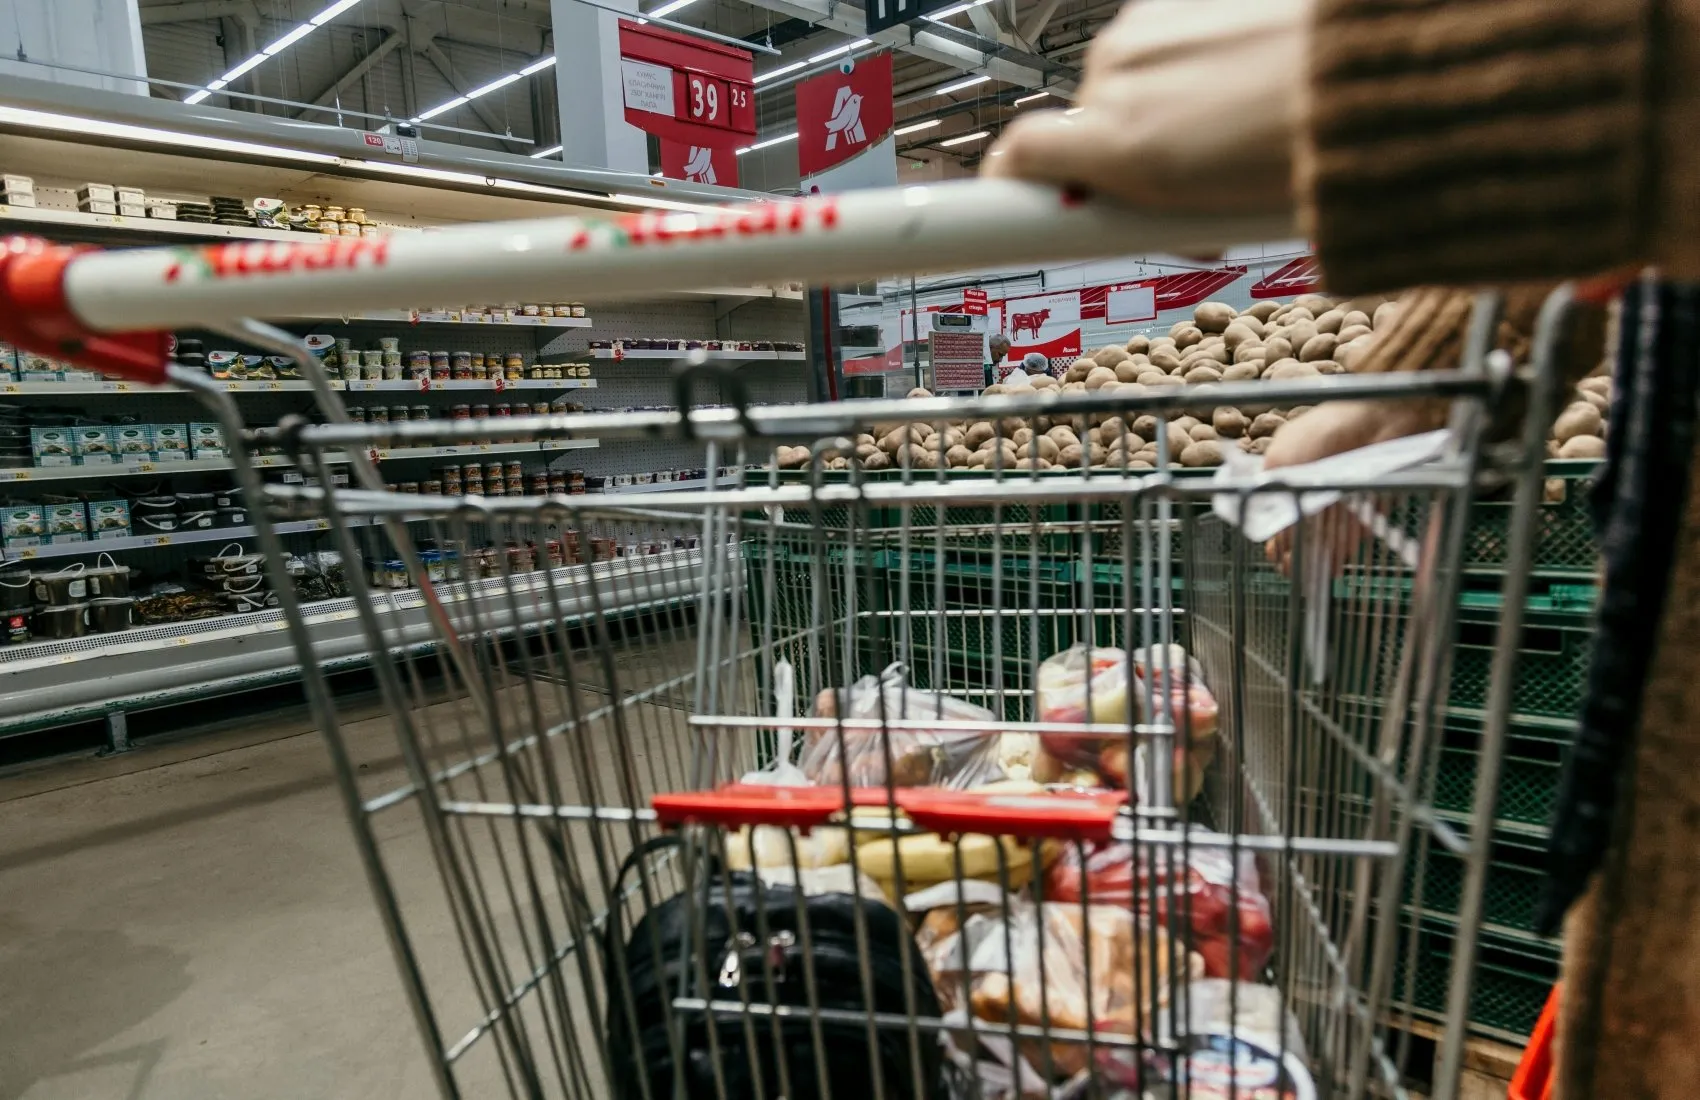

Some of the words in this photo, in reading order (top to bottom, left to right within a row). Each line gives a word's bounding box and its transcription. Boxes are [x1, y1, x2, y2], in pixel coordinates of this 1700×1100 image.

[692, 79, 718, 121] 39
[732, 88, 747, 108] 25
[367, 136, 382, 145] 120
